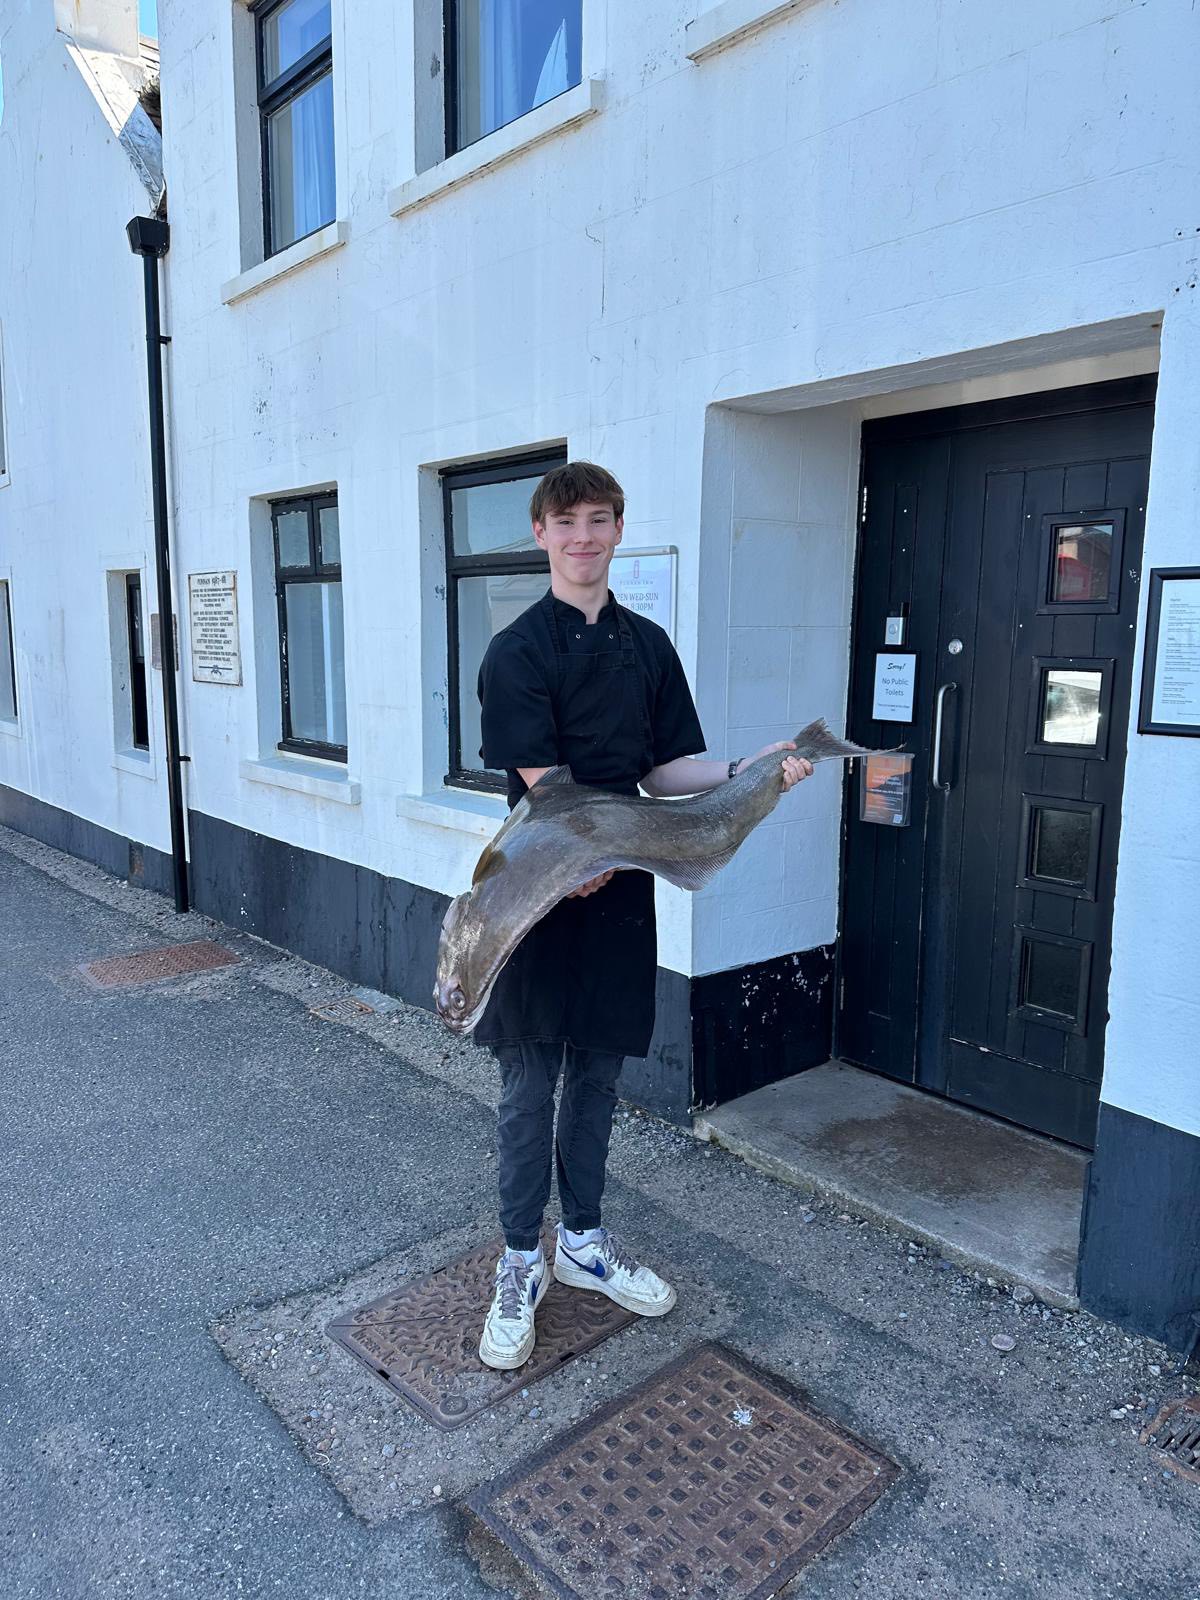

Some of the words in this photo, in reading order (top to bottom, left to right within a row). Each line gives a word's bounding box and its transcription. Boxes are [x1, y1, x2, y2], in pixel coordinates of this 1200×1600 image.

[629, 592, 659, 601] WED-SUN
[887, 662, 906, 672] Sorry!
[891, 678, 909, 686] Public
[885, 688, 904, 697] Toilets
